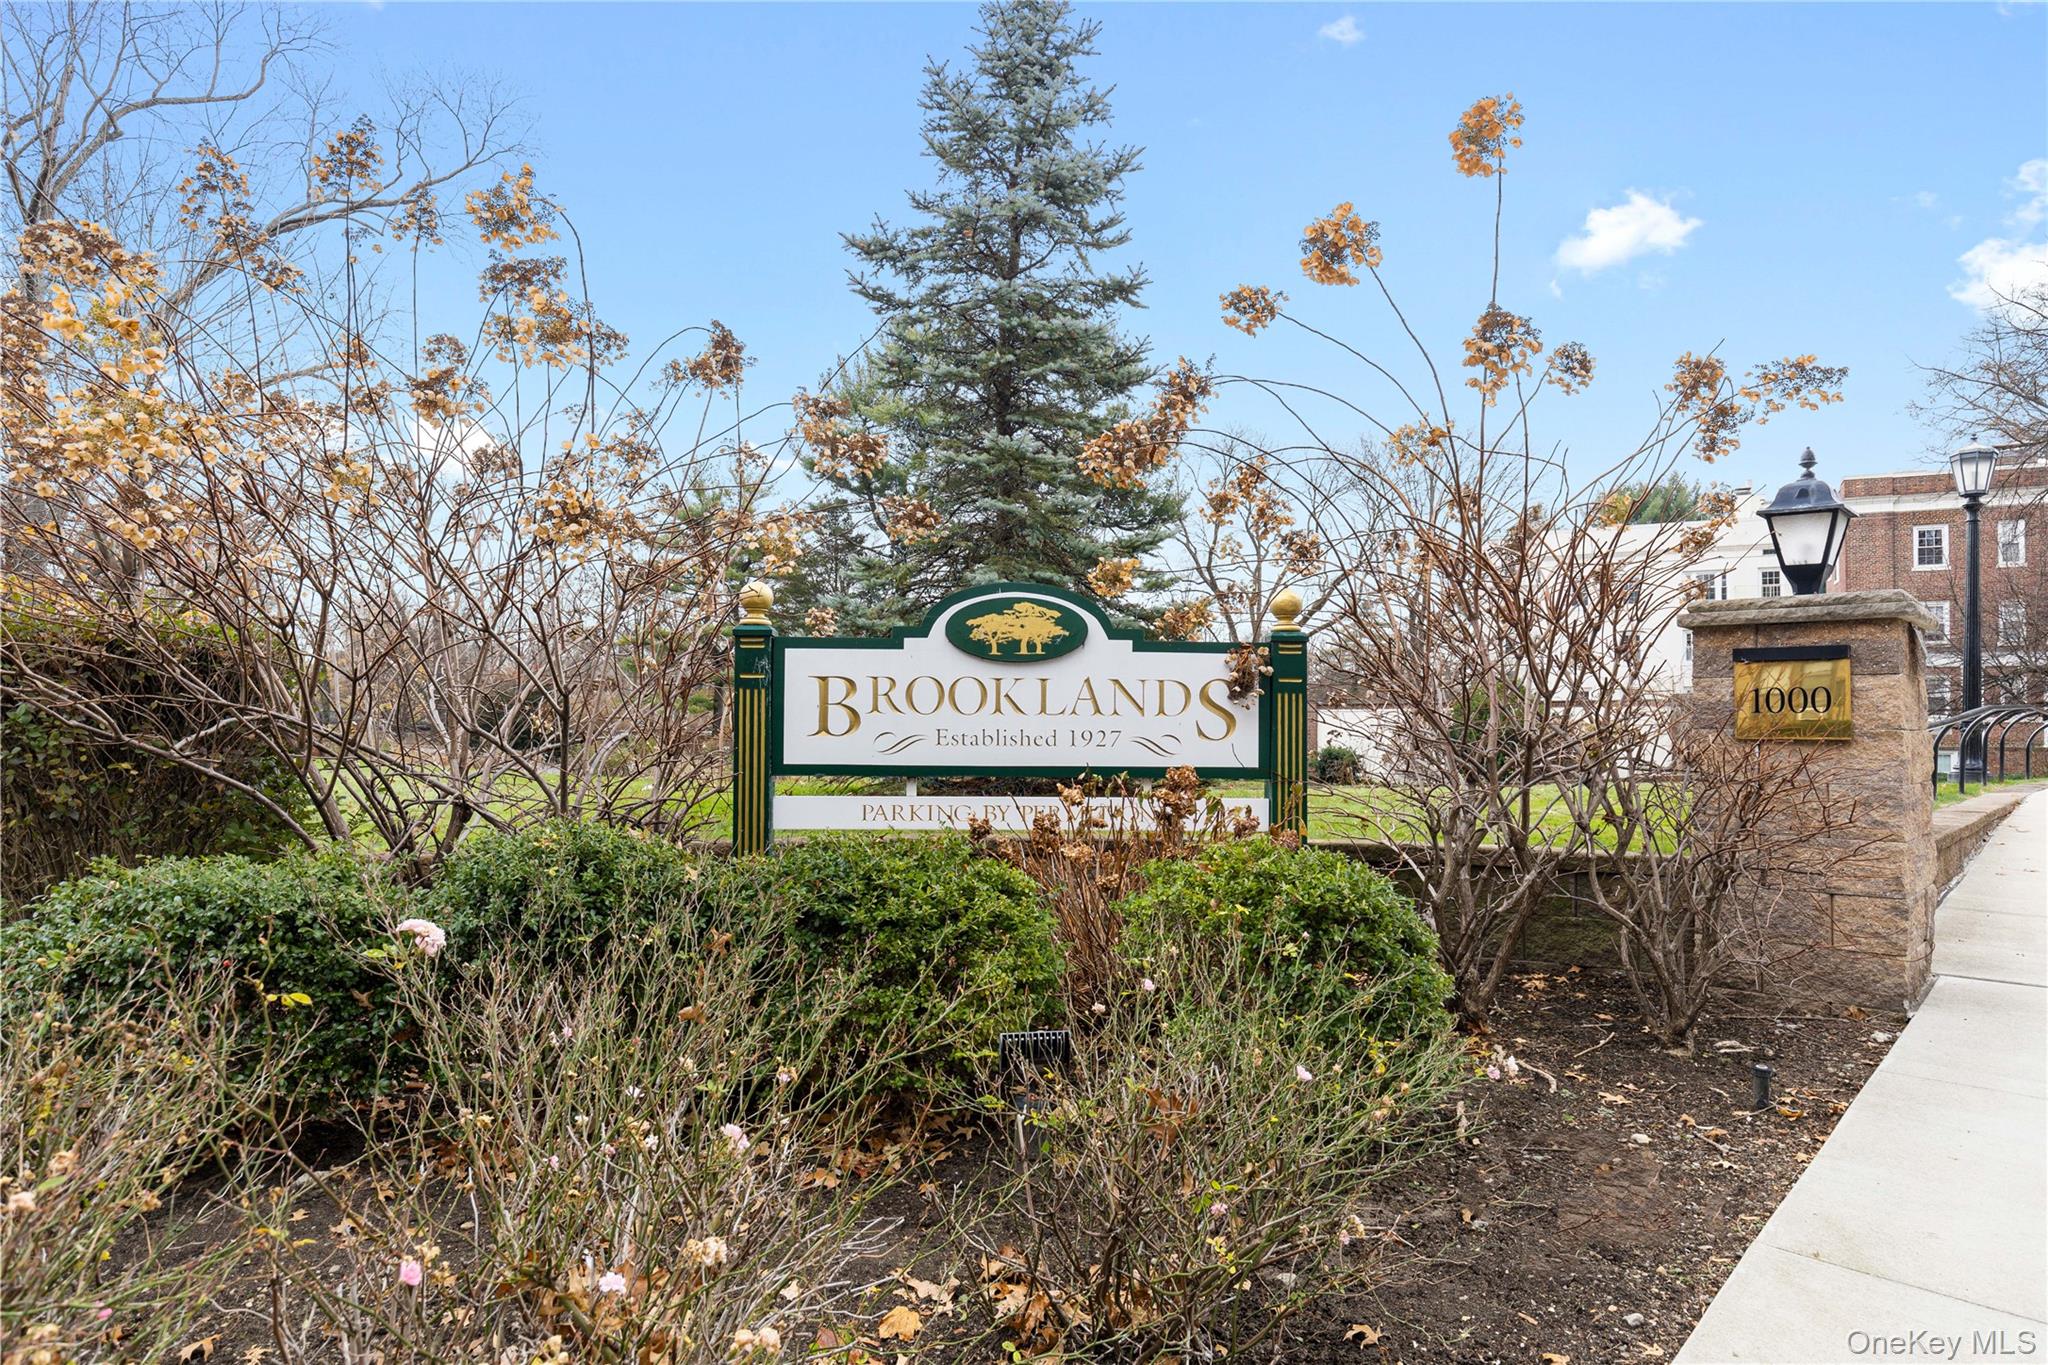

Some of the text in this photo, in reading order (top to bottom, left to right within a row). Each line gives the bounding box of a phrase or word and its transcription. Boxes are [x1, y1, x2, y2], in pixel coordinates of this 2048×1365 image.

[809, 675, 1236, 741] BROOKLANDS
[1751, 686, 1832, 714] 1000
[936, 728, 1122, 748] Established 1927
[862, 804, 972, 822] PARKING
[984, 804, 1010, 822] BY
